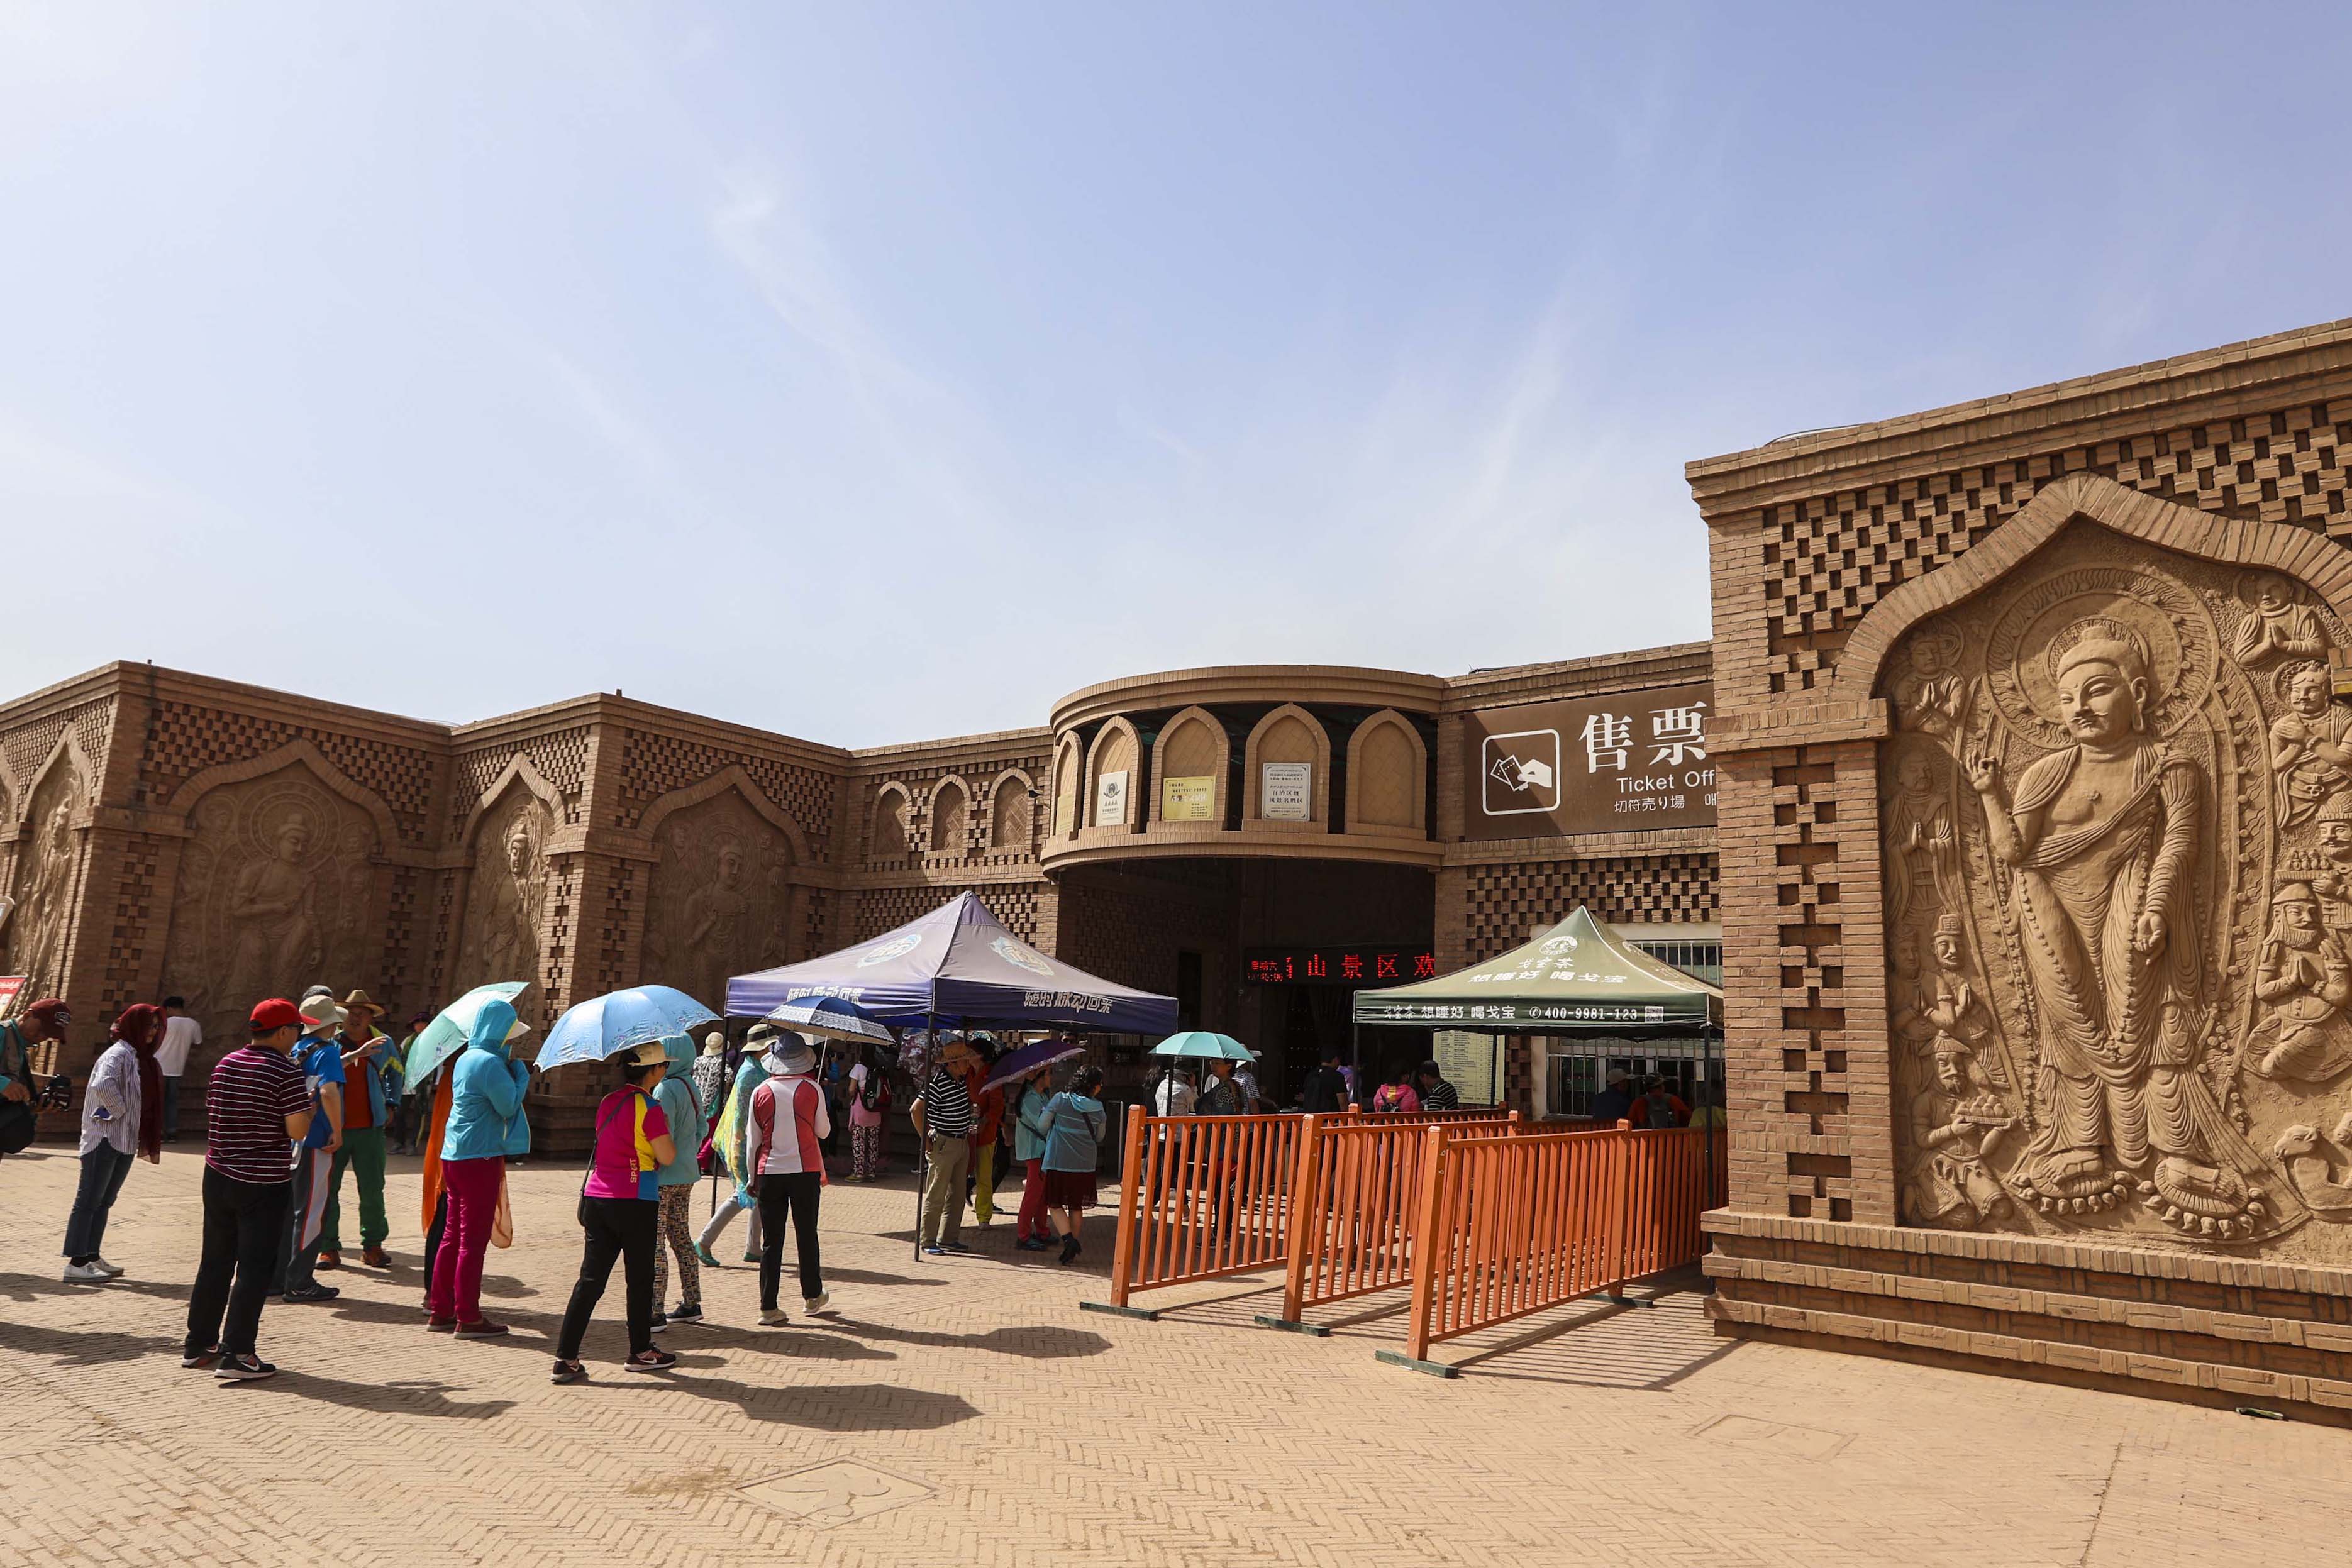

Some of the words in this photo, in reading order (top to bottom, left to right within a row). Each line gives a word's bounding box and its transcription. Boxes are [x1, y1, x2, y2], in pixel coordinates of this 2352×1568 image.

[1578, 701, 1707, 773] 售票
[1616, 774, 1675, 793] Ticket
[1685, 770, 1715, 787] Off
[1614, 795, 1685, 813] 切符売り場
[1421, 1005, 1464, 1019] 想睡好
[1470, 1005, 1516, 1019] 喝戈宝
[1544, 1007, 1637, 1020] 400-9981-123
